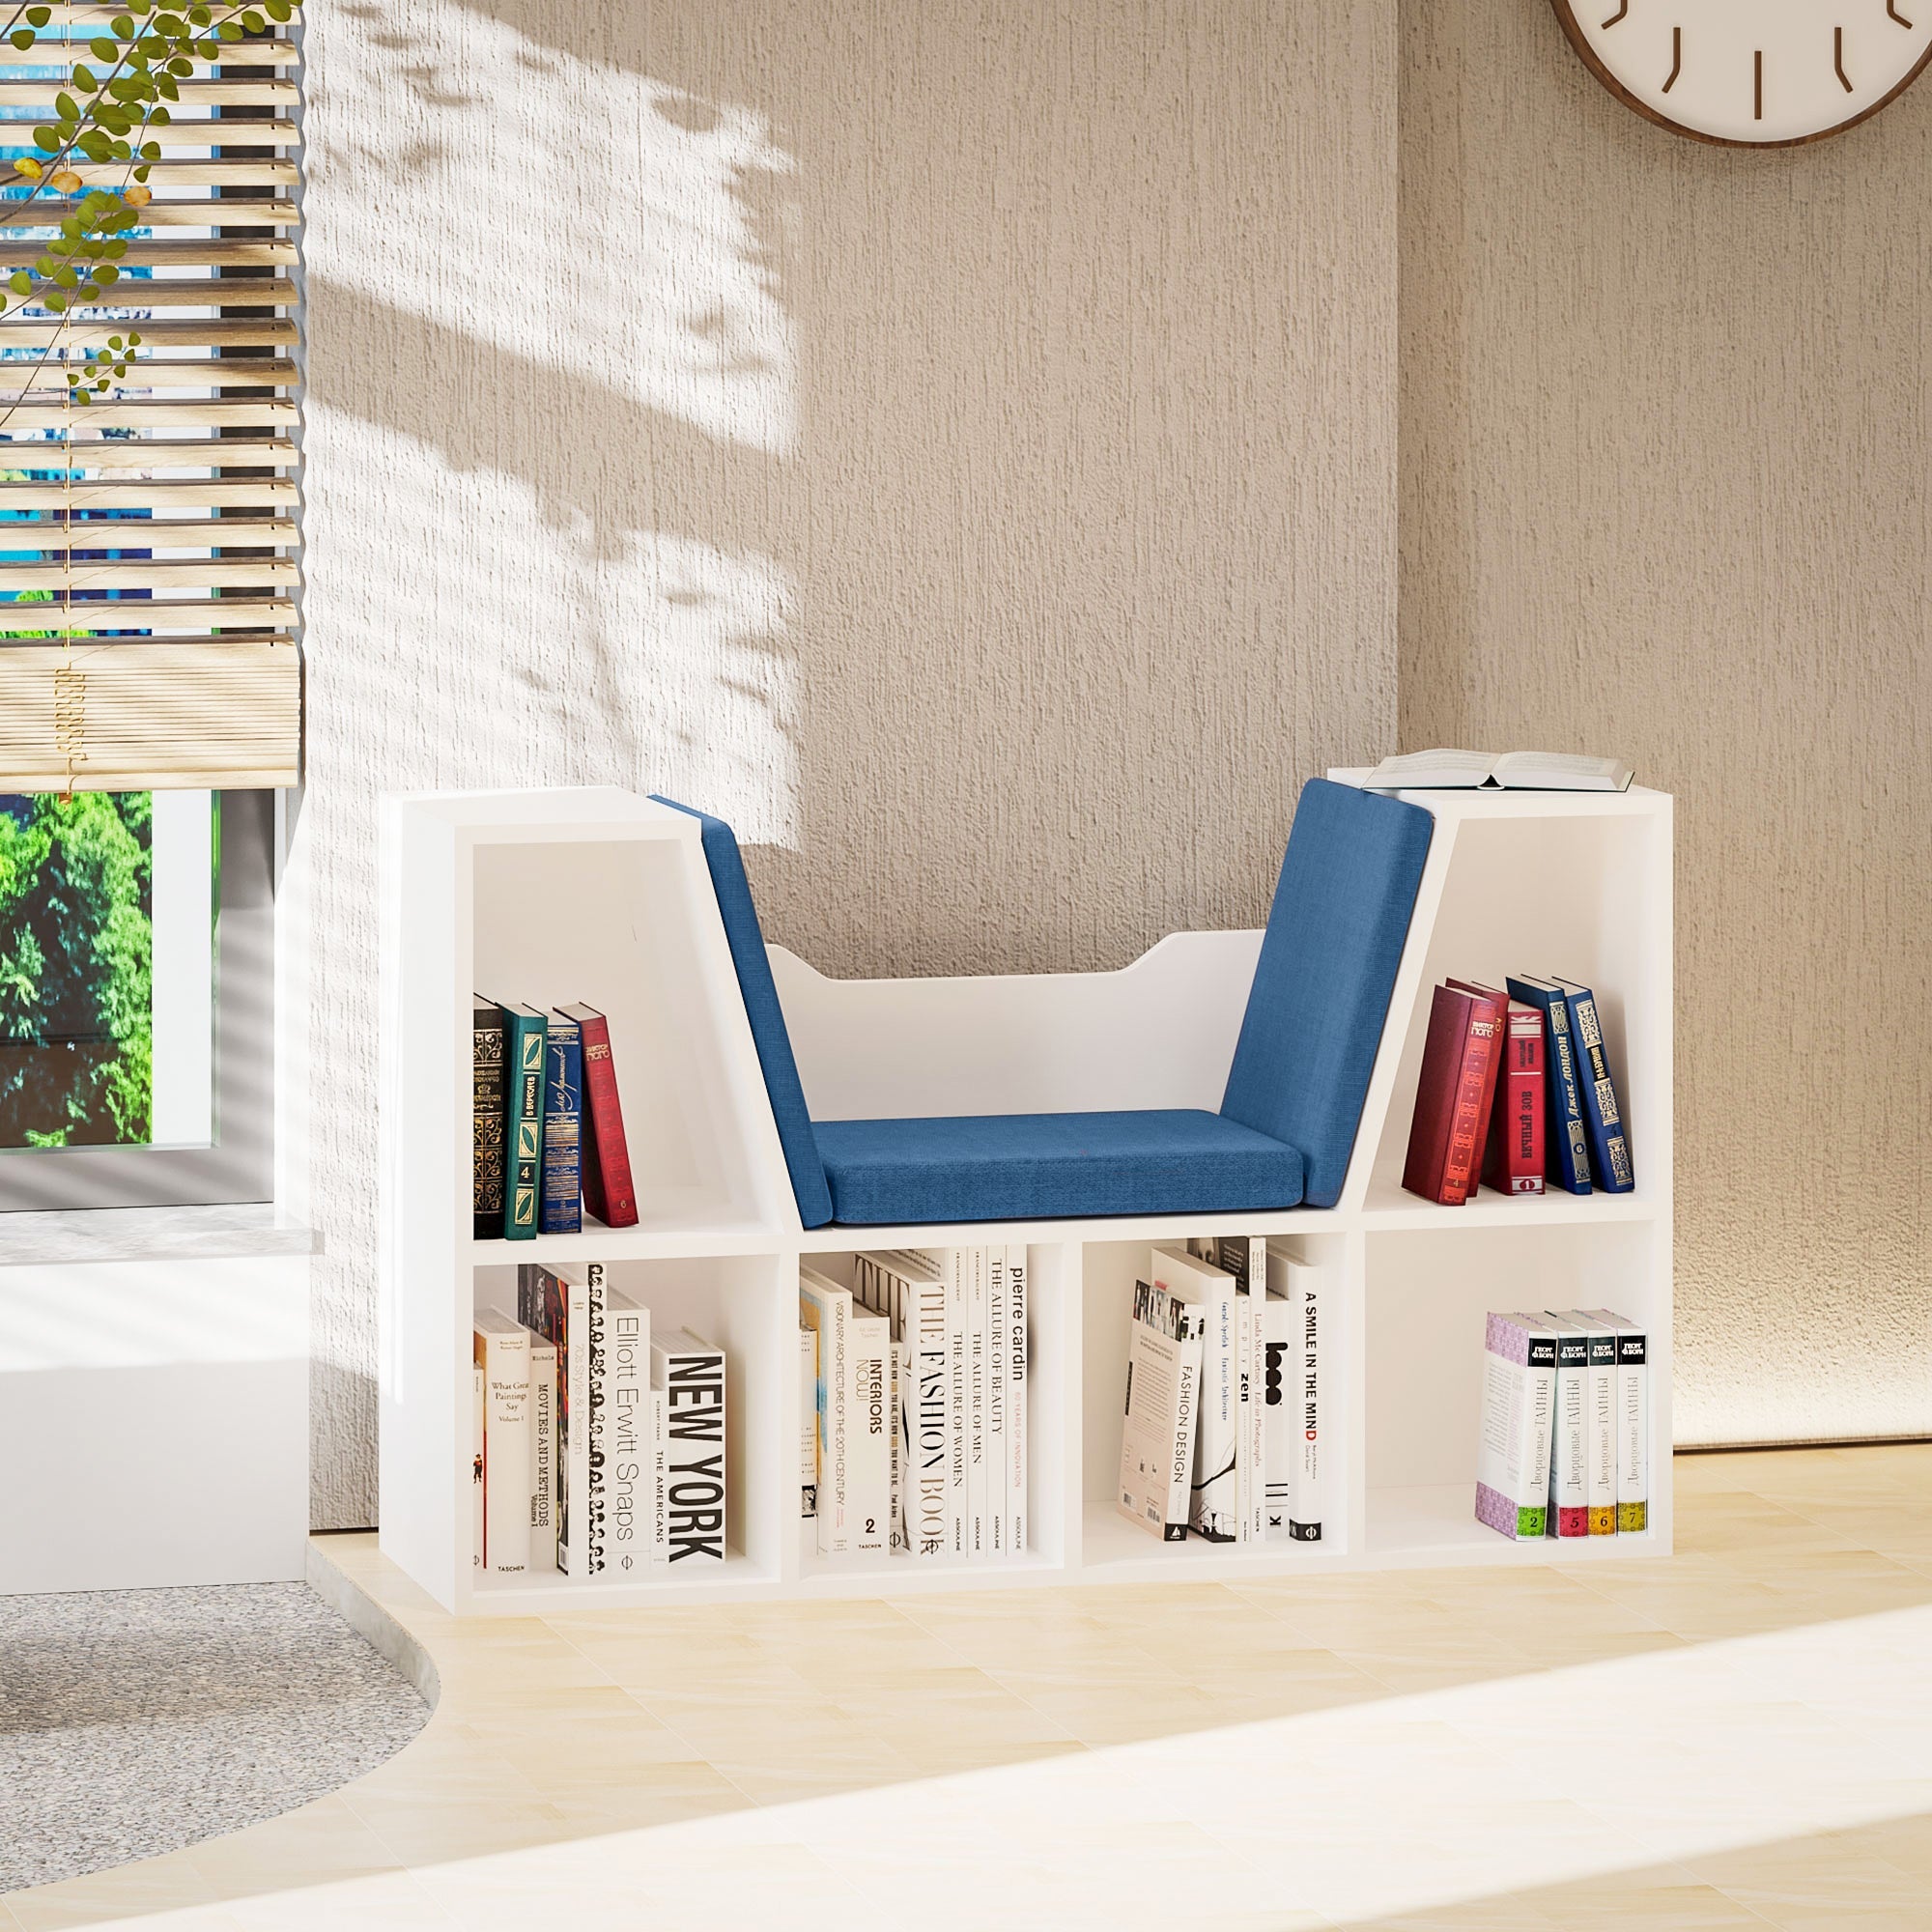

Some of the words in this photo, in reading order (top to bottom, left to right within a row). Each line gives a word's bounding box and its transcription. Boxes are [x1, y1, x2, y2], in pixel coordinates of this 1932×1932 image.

[1521, 1091, 1533, 1111] ЗОВ
[1519, 1114, 1533, 1159] ВЕЧНЫЙ
[521, 1166, 530, 1179] 4
[991, 1259, 1003, 1291] THE
[1009, 1266, 1025, 1320] pierre
[1305, 1292, 1318, 1302] A
[836, 1300, 845, 1341] VISIONARY
[920, 1285, 945, 1344] THE
[991, 1293, 1003, 1350] ALLURE
[1254, 1313, 1263, 1337] Linda
[1305, 1306, 1318, 1350] SMILE
[616, 1318, 639, 1380] Elliott
[953, 1330, 963, 1360] THE
[972, 1330, 981, 1359] THE
[991, 1352, 1003, 1373] OF
[1011, 1325, 1026, 1381] cardin
[1305, 1352, 1318, 1368] IN
[491, 1381, 512, 1390] What
[836, 1342, 845, 1405] ARCHITECTURE
[856, 1358, 869, 1402] NOW!
[953, 1361, 963, 1413] ALLURE
[972, 1360, 981, 1412] ALLURE
[1240, 1373, 1249, 1403] zen
[1305, 1371, 1318, 1399] THE
[505, 1402, 519, 1412] Say
[538, 1383, 549, 1435] MOVIES
[668, 1355, 723, 1442] NEW
[869, 1358, 882, 1435] INTERIORS
[919, 1350, 946, 1469] FASHION
[991, 1375, 1003, 1435] BEAUTY
[1178, 1365, 1193, 1427] FASHION
[1254, 1391, 1263, 1408] Life
[572, 1410, 585, 1455] Design
[616, 1387, 639, 1455] Erwitt
[836, 1417, 845, 1435] THE
[953, 1415, 963, 1434] OF
[972, 1414, 981, 1433] OF
[1253, 1417, 1263, 1468] Photographs
[1305, 1402, 1318, 1441] MIND
[538, 1436, 549, 1465] AND
[656, 1451, 665, 1472] THE
[953, 1435, 963, 1488] WOMEN
[972, 1435, 981, 1464] MEN
[1174, 1432, 1188, 1484] DESIGN
[1530, 1430, 1546, 1491] Дворцовые
[1567, 1430, 1584, 1491] Дворцовые
[1598, 1429, 1611, 1491] Дворцовые
[1627, 1426, 1641, 1486] Дворцовые
[538, 1465, 549, 1527] METHODS
[611, 1463, 640, 1542] Snaps
[836, 1462, 845, 1506] CENTURY
[656, 1475, 665, 1543] AMERICANS
[668, 1453, 724, 1563] YORK
[865, 1518, 875, 1533] 2
[919, 1478, 946, 1555] BOOK
[1529, 1517, 1538, 1527] 2
[1570, 1517, 1579, 1528] 5
[1600, 1516, 1608, 1526] 6
[1629, 1512, 1636, 1523] 7
